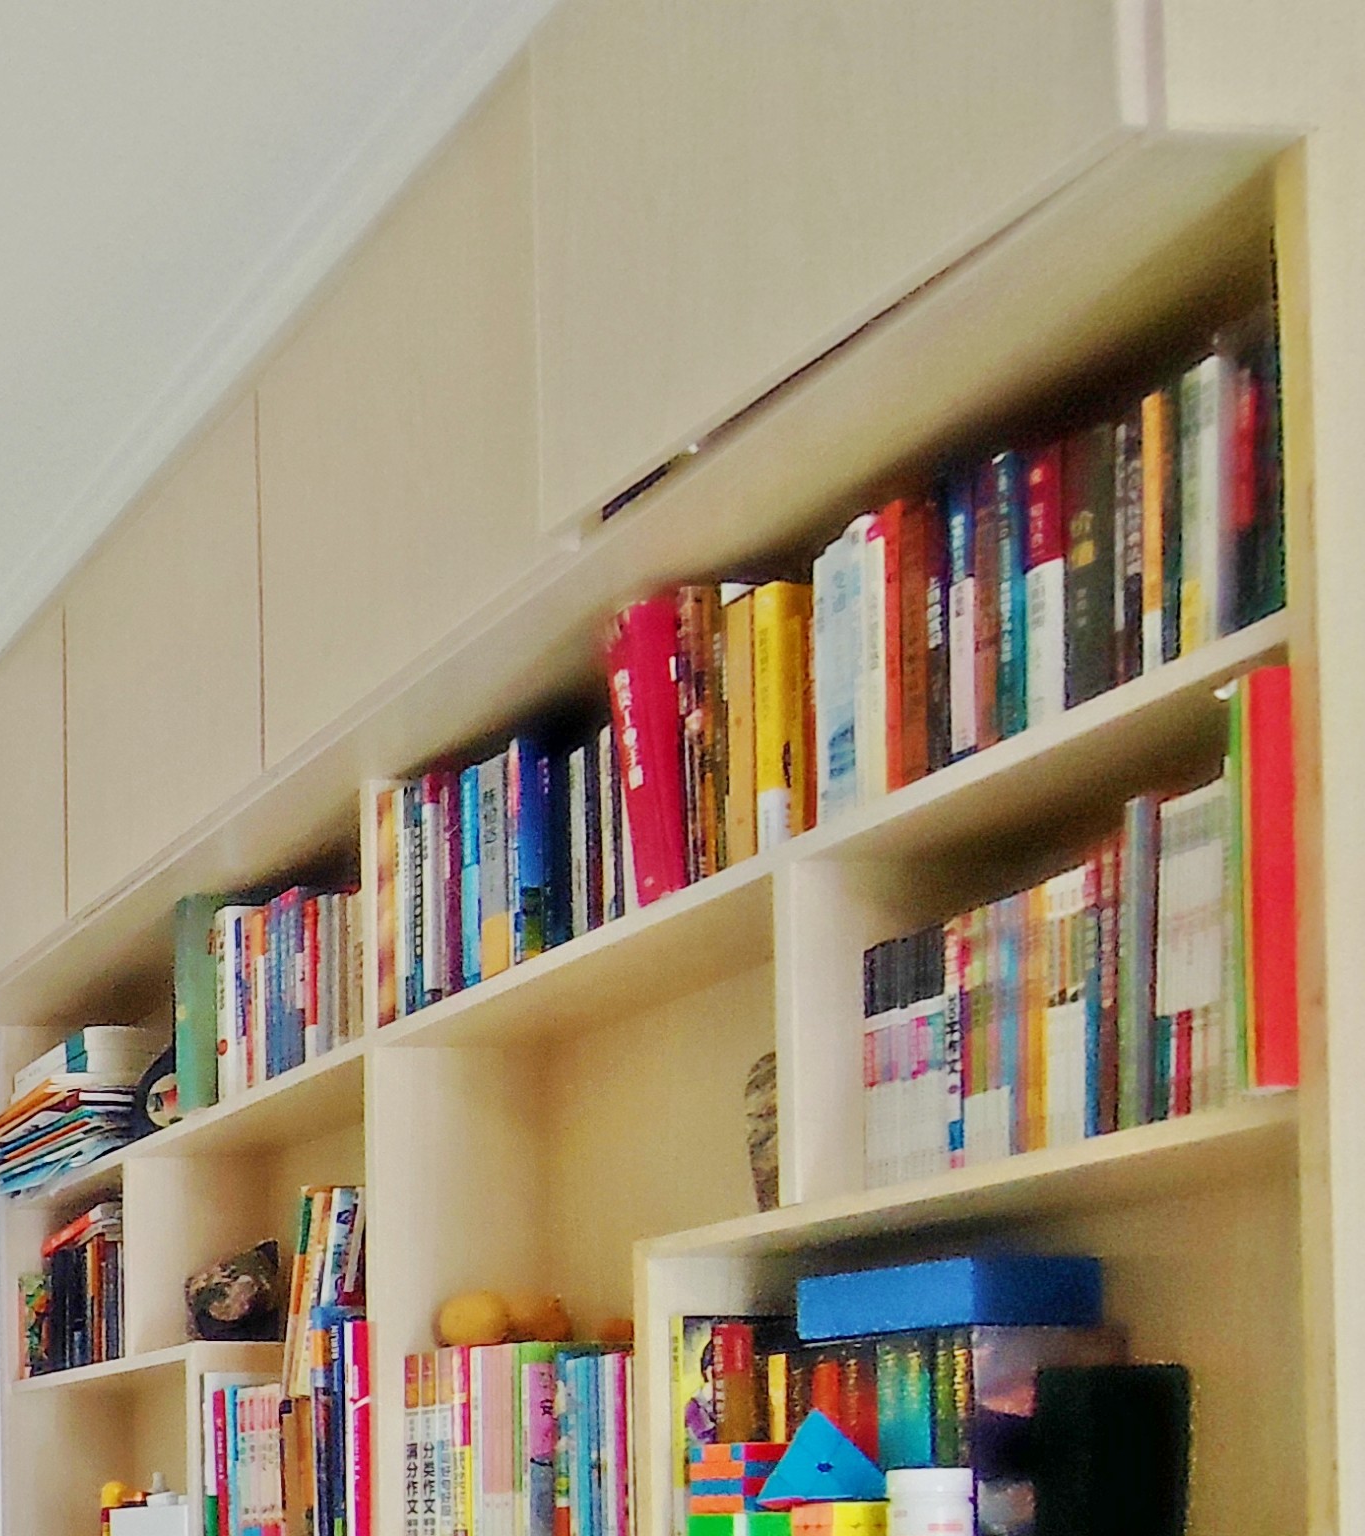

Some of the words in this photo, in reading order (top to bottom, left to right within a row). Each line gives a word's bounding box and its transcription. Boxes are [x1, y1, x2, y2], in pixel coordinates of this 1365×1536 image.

[406, 1442, 419, 1515] 满分作文
[423, 1441, 436, 1514] 分类作文
